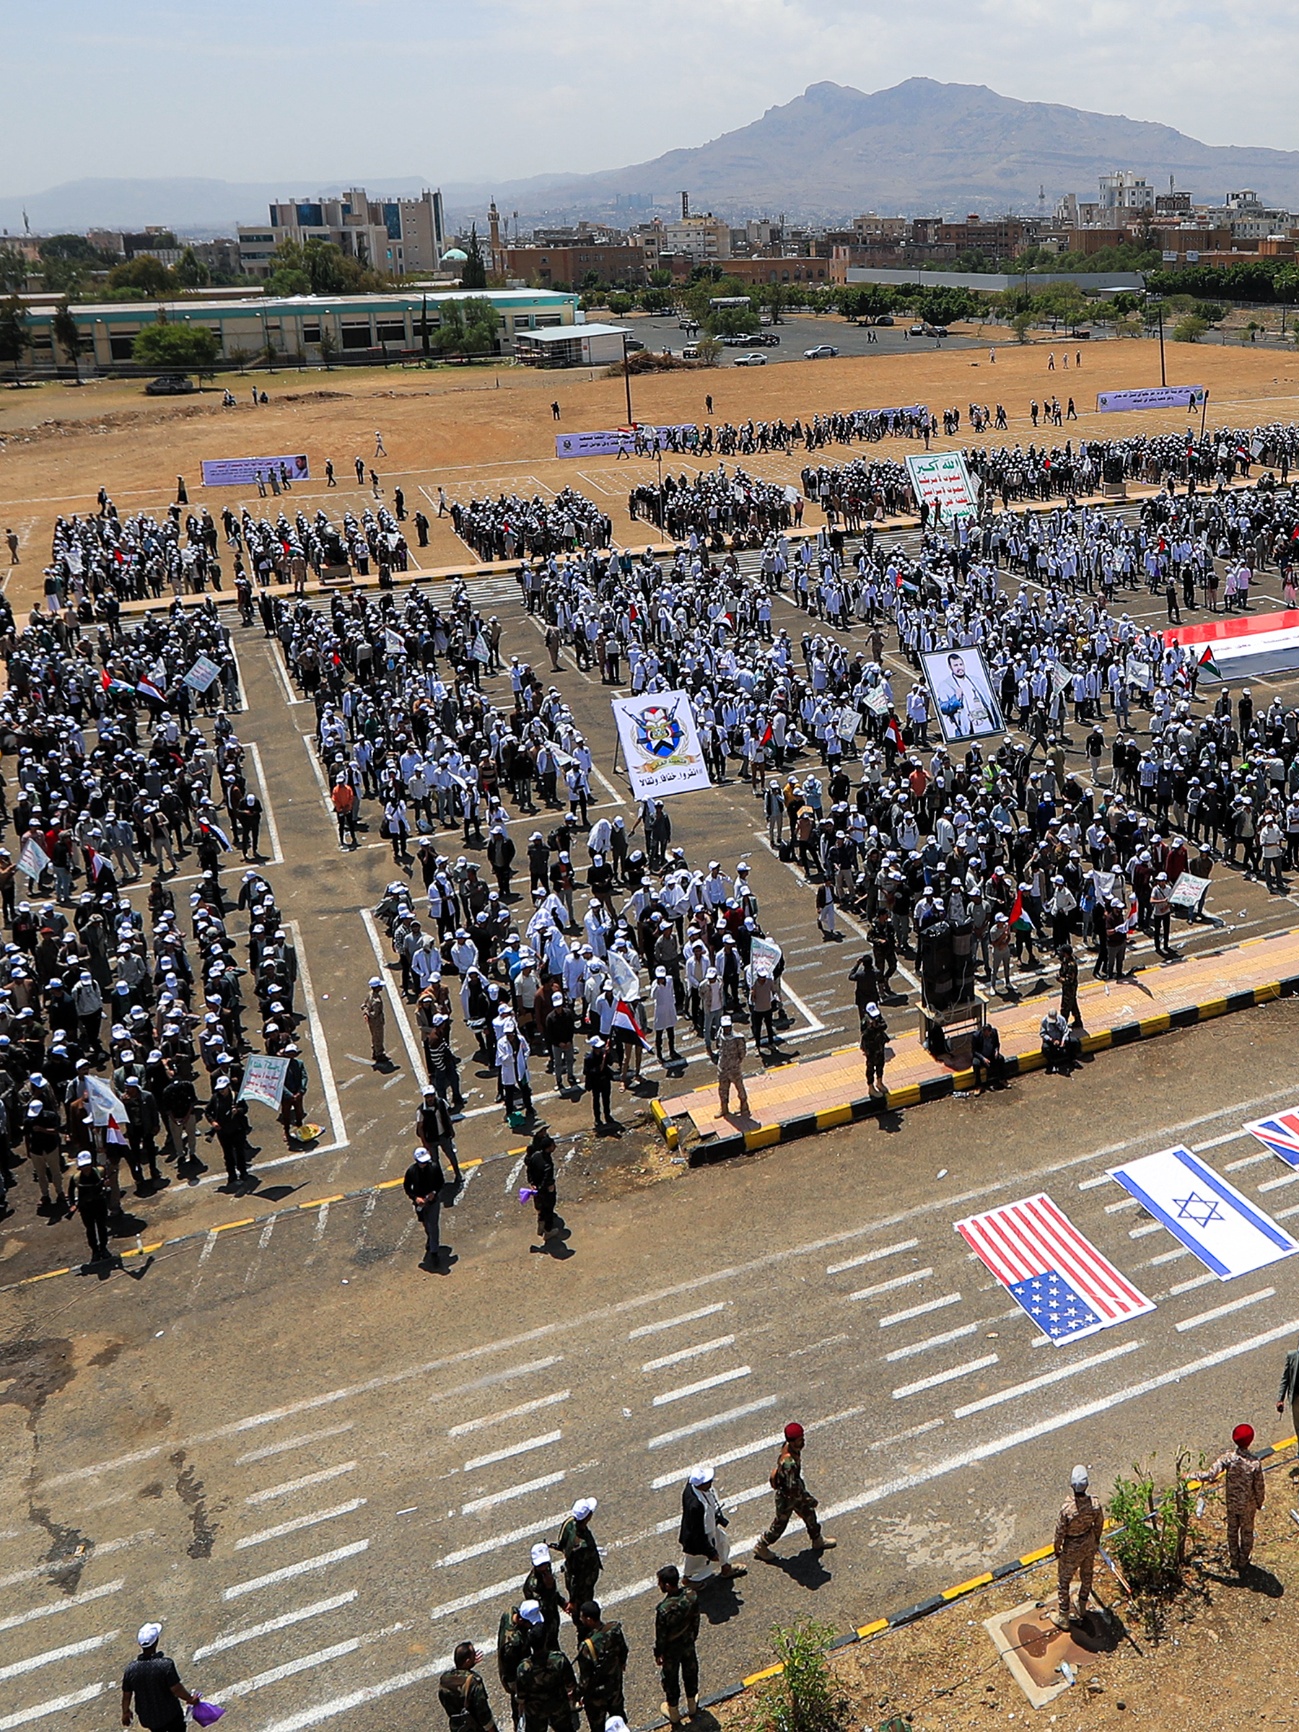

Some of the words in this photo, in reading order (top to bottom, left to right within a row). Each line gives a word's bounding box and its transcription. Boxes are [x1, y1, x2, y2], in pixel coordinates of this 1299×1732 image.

[916, 458, 940, 475] أكبر
[942, 458, 960, 469] الله
[943, 472, 962, 483] الموت
[947, 484, 967, 495] الموت
